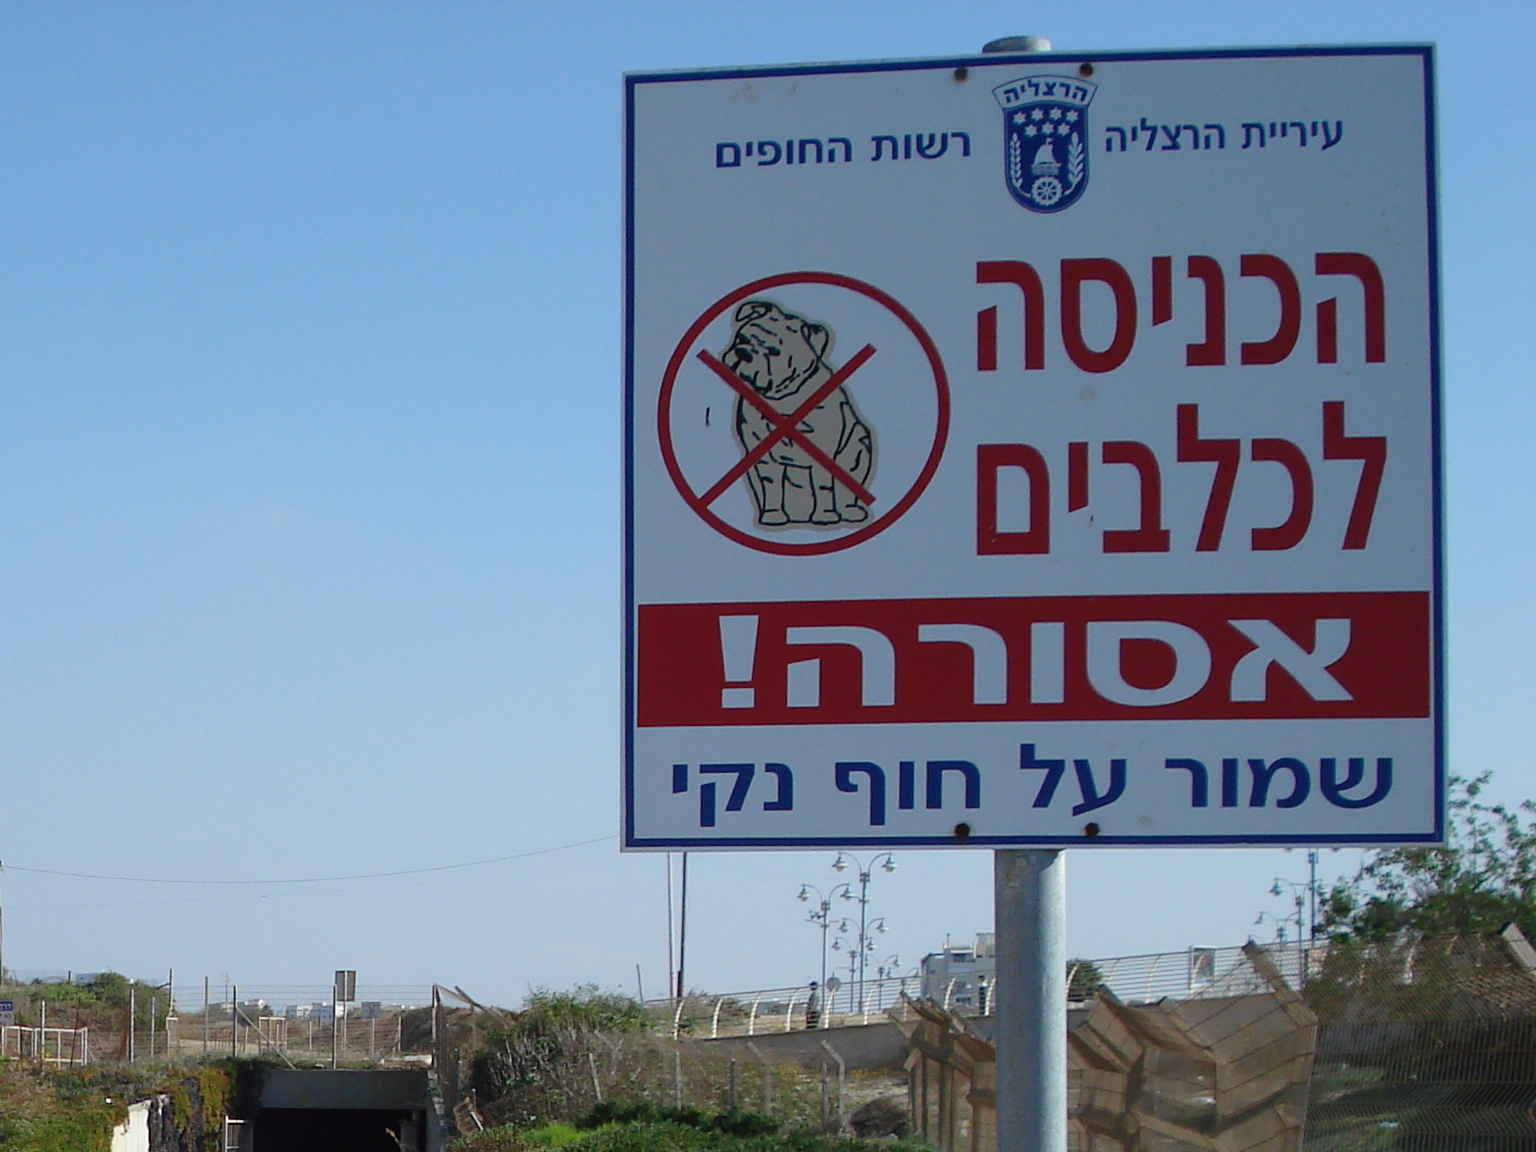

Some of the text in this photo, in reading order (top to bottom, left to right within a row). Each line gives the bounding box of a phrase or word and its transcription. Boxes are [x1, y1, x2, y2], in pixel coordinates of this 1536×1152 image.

[1003, 79, 1088, 104] הרצליה
[1104, 116, 1345, 153] עיריית הרצליה
[715, 131, 972, 170] רשות החופים
[976, 252, 1386, 374] הכניסה
[976, 401, 1388, 557] לכלבים
[718, 613, 1355, 710] אסורה!
[671, 742, 1395, 829] שמור על חוף נקי
